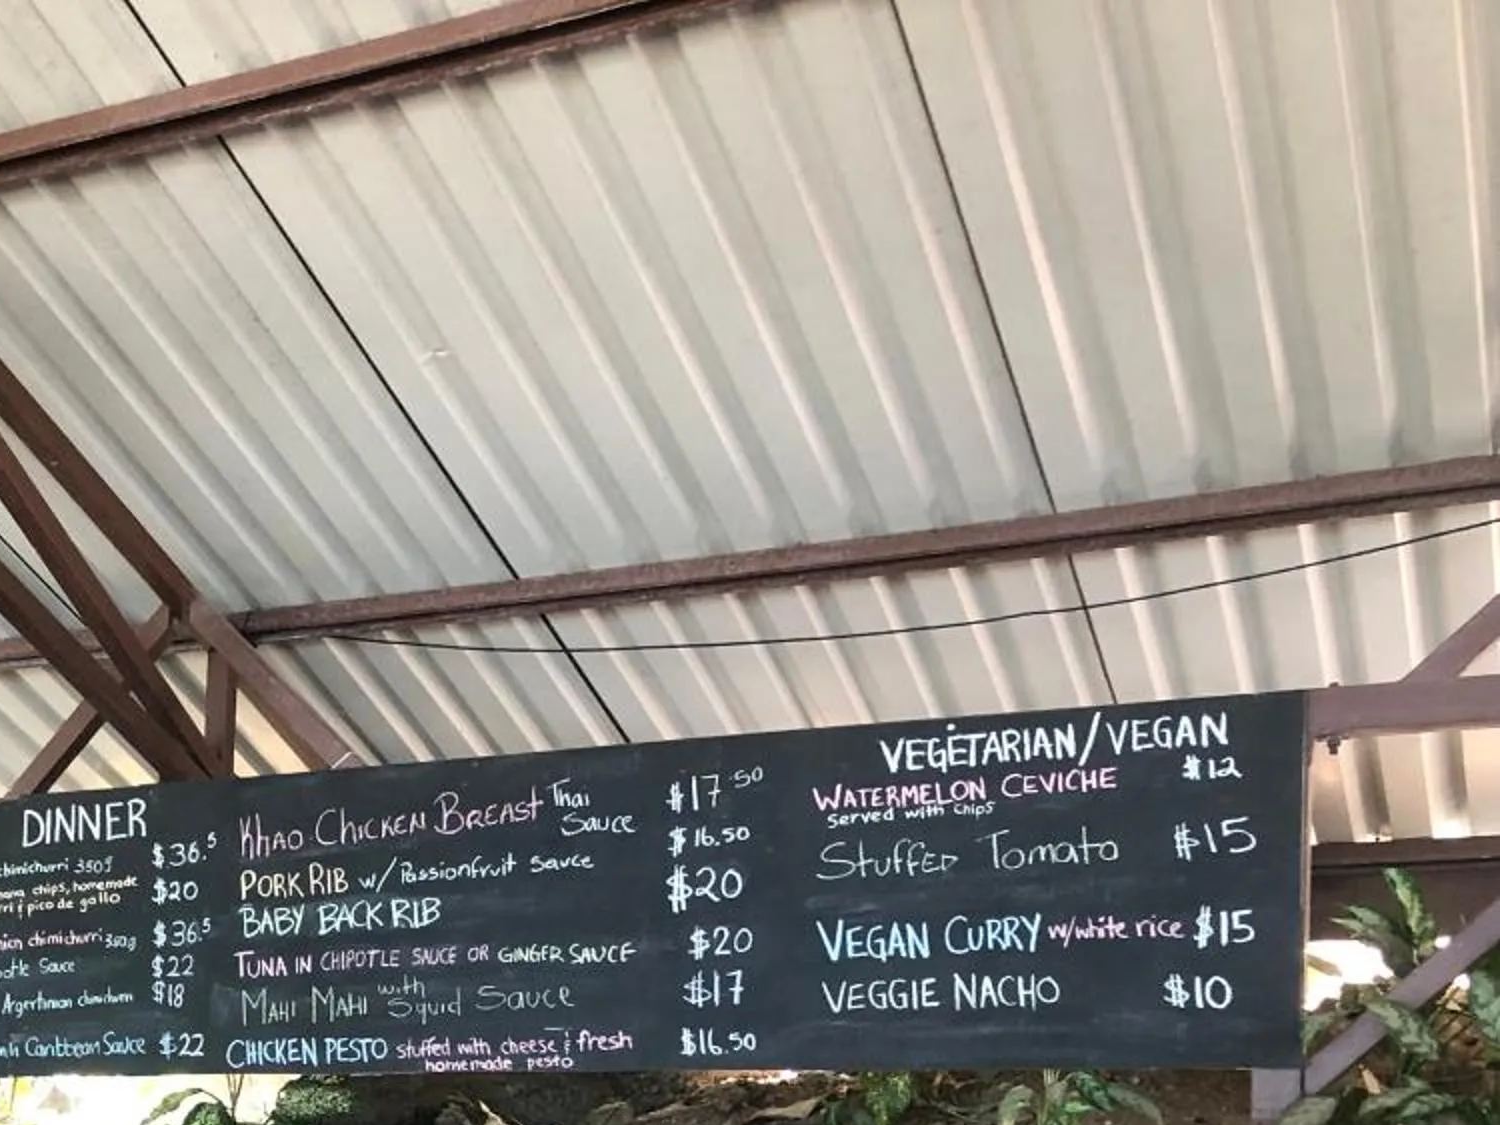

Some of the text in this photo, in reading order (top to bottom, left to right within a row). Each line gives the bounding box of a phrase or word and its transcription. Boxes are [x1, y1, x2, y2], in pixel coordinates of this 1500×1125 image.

[548, 777, 591, 808] Thai
[812, 754, 1243, 811] WATERMELON CEVICHE $12
[21, 798, 147, 848] DINNER
[560, 813, 639, 837] Sauce
[827, 807, 895, 830] served
[905, 802, 945, 820] with
[974, 826, 1119, 872] Tomato
[1174, 816, 1257, 862] $15
[151, 876, 199, 906] $20
[239, 869, 305, 901] PORK
[308, 862, 349, 896] RIB
[530, 854, 595, 874] sauce
[28, 899, 55, 917] pico
[56, 898, 74, 911] de
[238, 864, 744, 939] BABY BACK RIB $20
[233, 926, 754, 979] TUNA IN CHIPOTLE SAUCE OR GINGER SAUCE $20
[815, 918, 931, 963] VEGAN
[944, 912, 1042, 955] CURRY
[1135, 914, 1186, 939] rice
[1193, 905, 1256, 950] $15
[39, 957, 76, 975] Sauce
[151, 954, 195, 979] $22
[151, 980, 185, 1009] $18
[241, 969, 745, 1027] MAHI MAHI with Squid Sauce $17
[821, 972, 1233, 1014] VEGGIE NACHO $10
[103, 1031, 148, 1056] Sauce
[159, 1031, 205, 1061] $22
[225, 1037, 319, 1070] CHICKEN
[325, 1037, 387, 1064] PESTO
[457, 1037, 492, 1056] with
[576, 1029, 633, 1051] fresh
[526, 1055, 574, 1071] pesto
